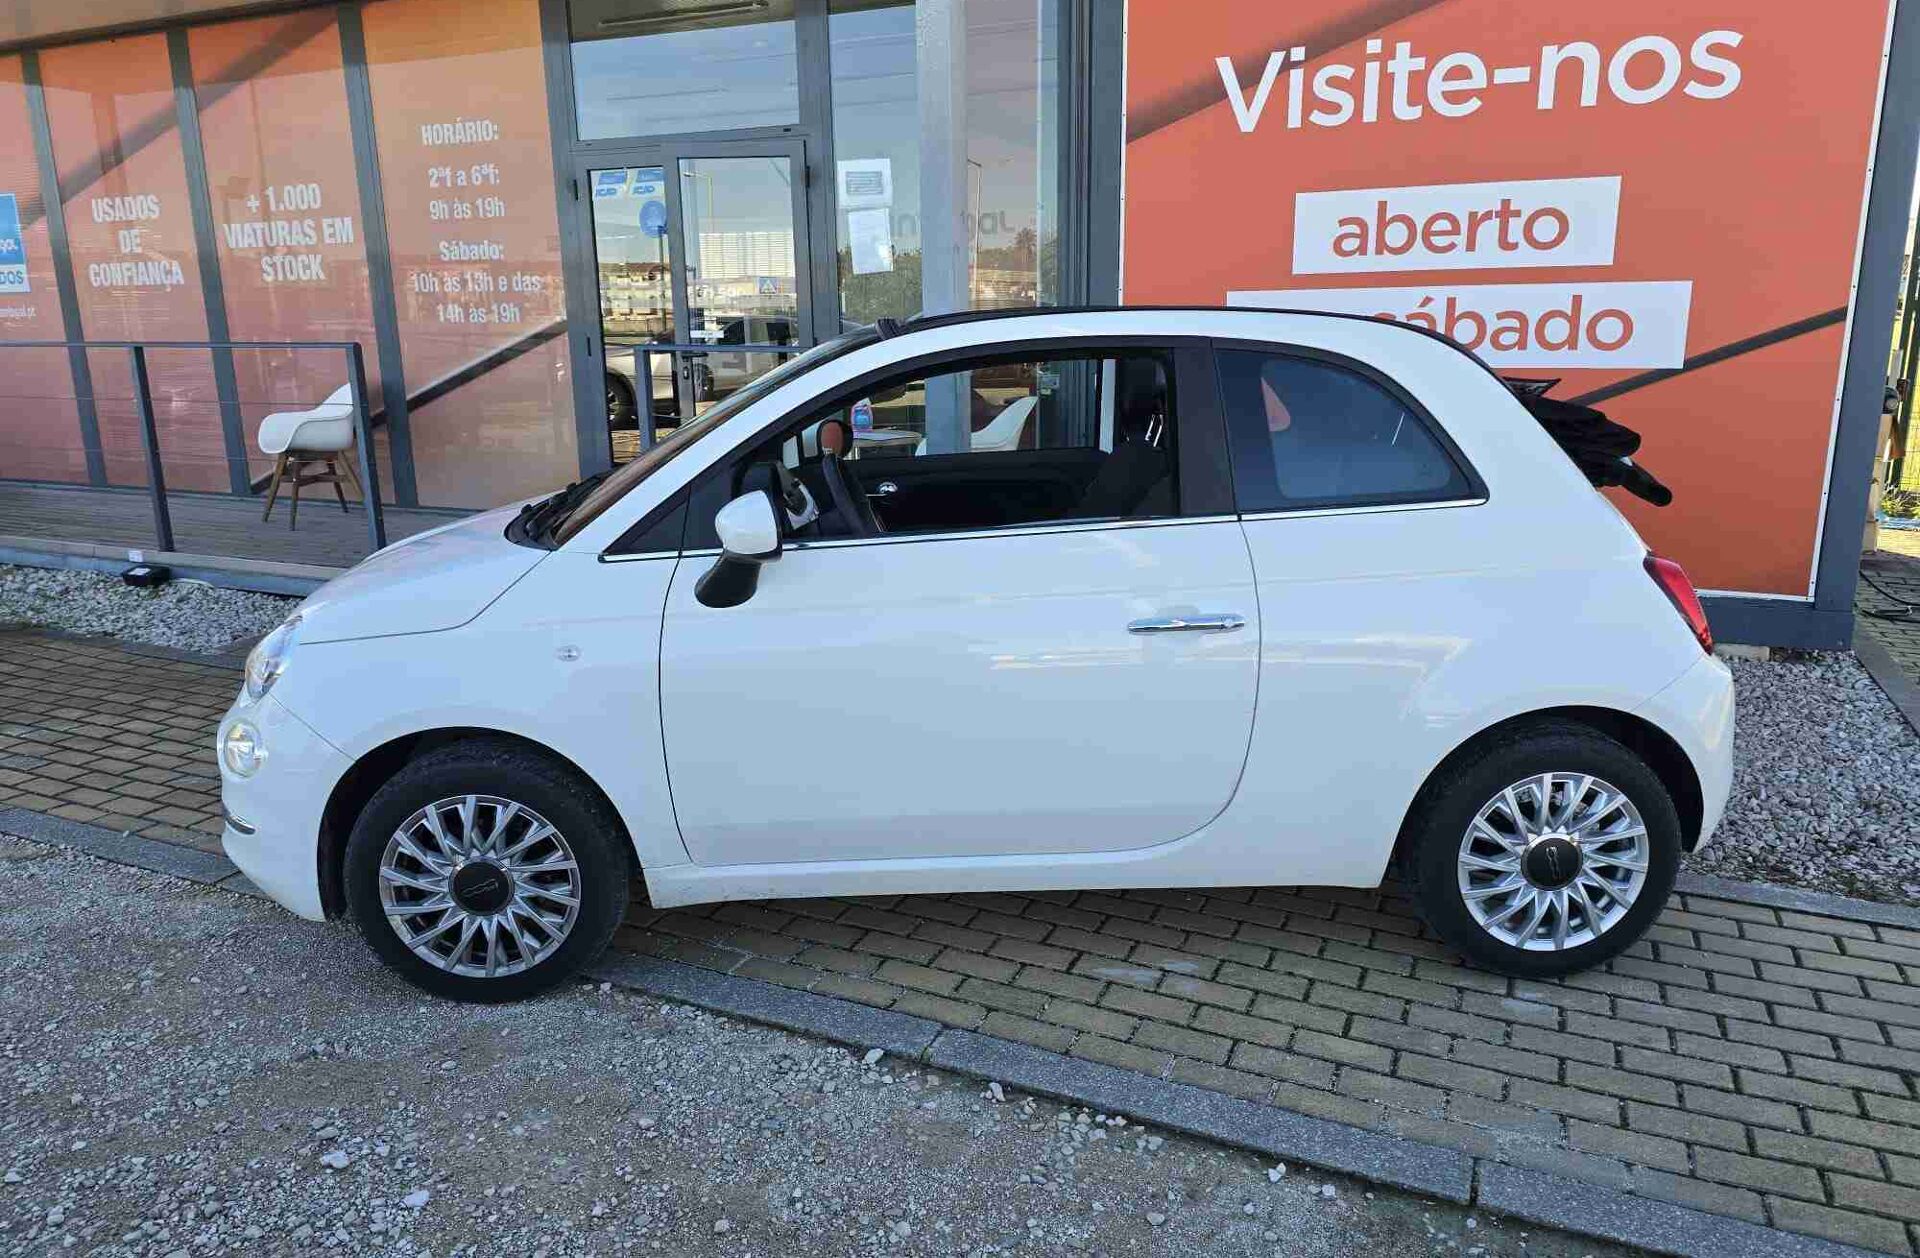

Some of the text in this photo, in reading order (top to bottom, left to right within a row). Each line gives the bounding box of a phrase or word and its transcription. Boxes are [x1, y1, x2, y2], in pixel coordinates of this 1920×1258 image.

[1215, 29, 1743, 133] Visite-nos
[421, 117, 498, 145] HORÁRIO:
[456, 170, 467, 186] a
[92, 194, 160, 222] USADOS
[265, 183, 321, 211] 1.000
[429, 199, 449, 220] 9h
[476, 196, 505, 218] 19h
[118, 229, 142, 254] DE
[223, 216, 354, 248] VIATURAS EM
[1331, 199, 1570, 258] aberto
[439, 240, 504, 260] Sábado:
[89, 260, 185, 292] CONFIANÇA
[261, 254, 326, 281] STOCK
[498, 275, 508, 292] e
[437, 303, 464, 323] 14h
[491, 302, 520, 323] 19h
[1374, 294, 1634, 351] ábado
